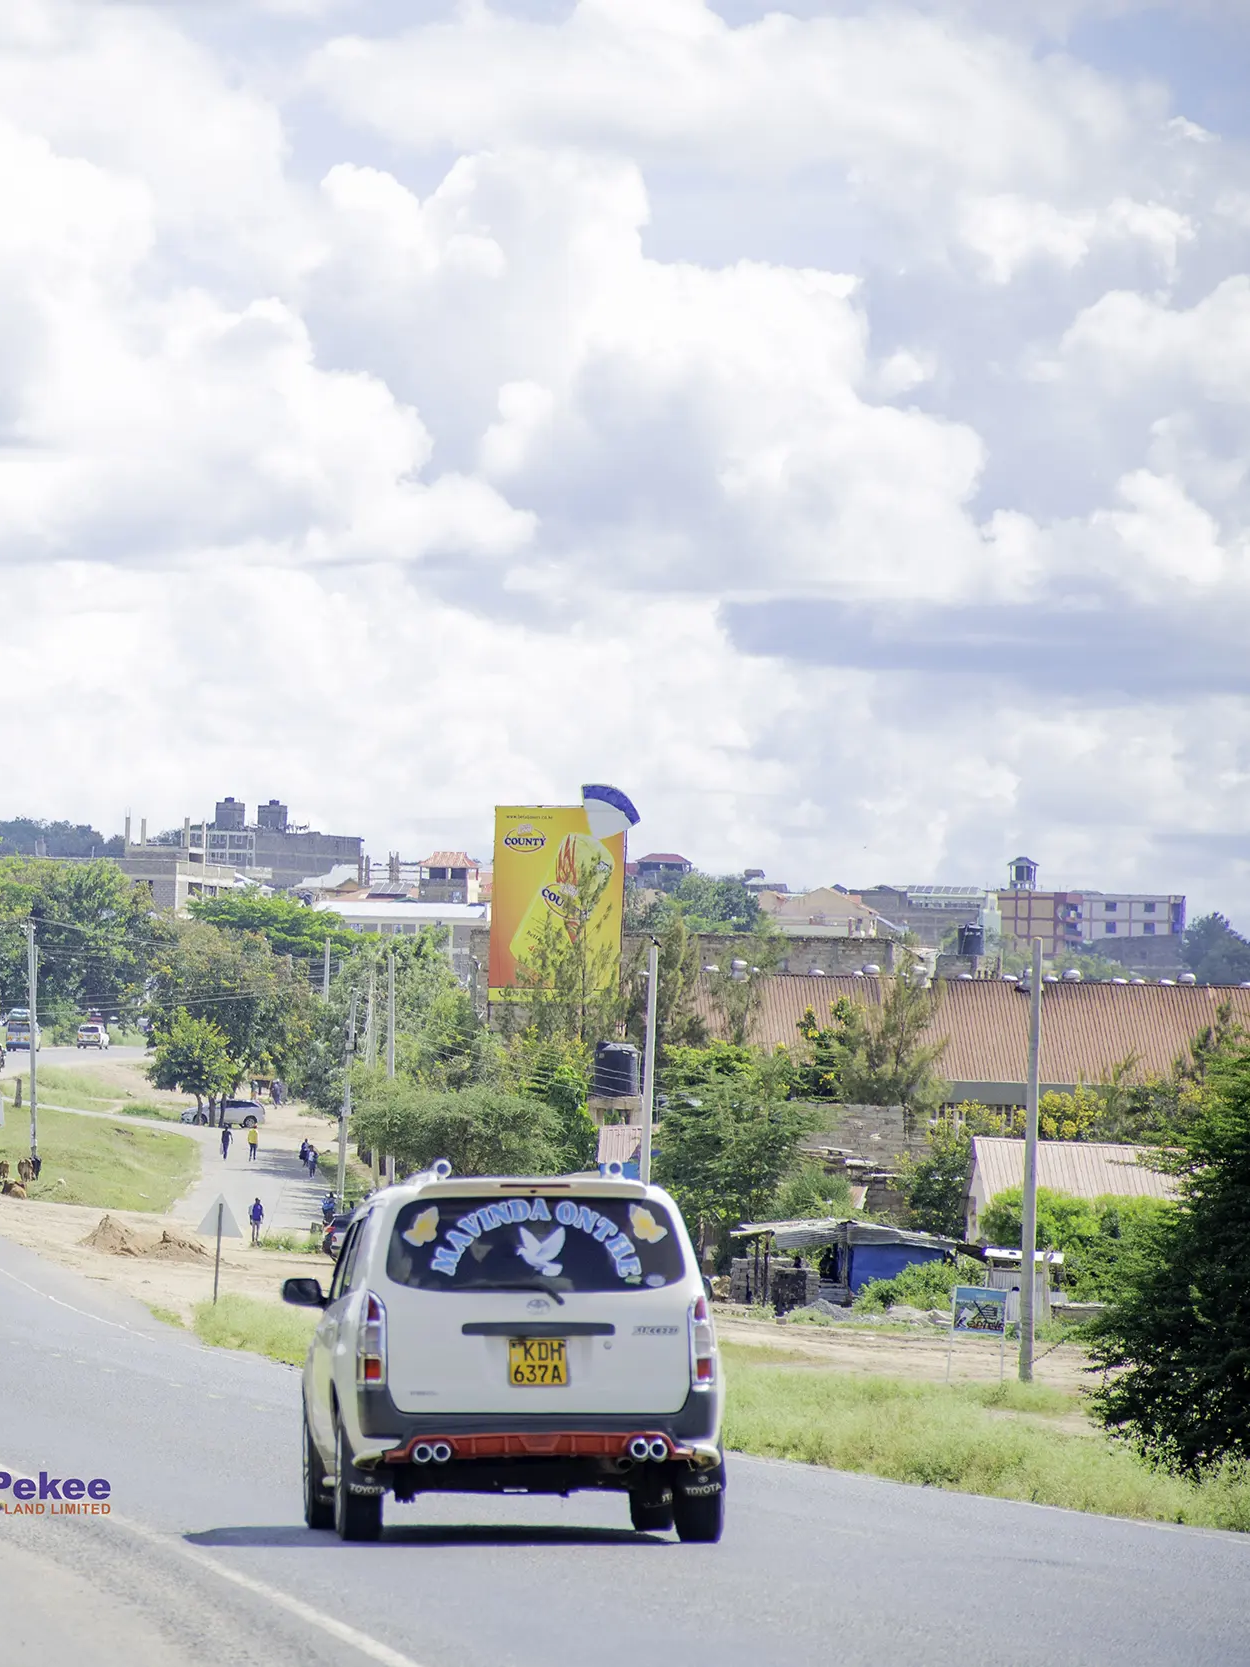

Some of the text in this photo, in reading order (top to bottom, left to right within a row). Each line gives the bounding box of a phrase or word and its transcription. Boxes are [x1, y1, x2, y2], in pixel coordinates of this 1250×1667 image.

[504, 837, 546, 846] COUNTY
[431, 1198, 551, 1277] MAVINDA
[524, 1342, 562, 1361] KDH
[513, 1365, 562, 1383] 637A
[350, 1483, 387, 1494] TOYOTA
[685, 1482, 723, 1495] TOYOTA
